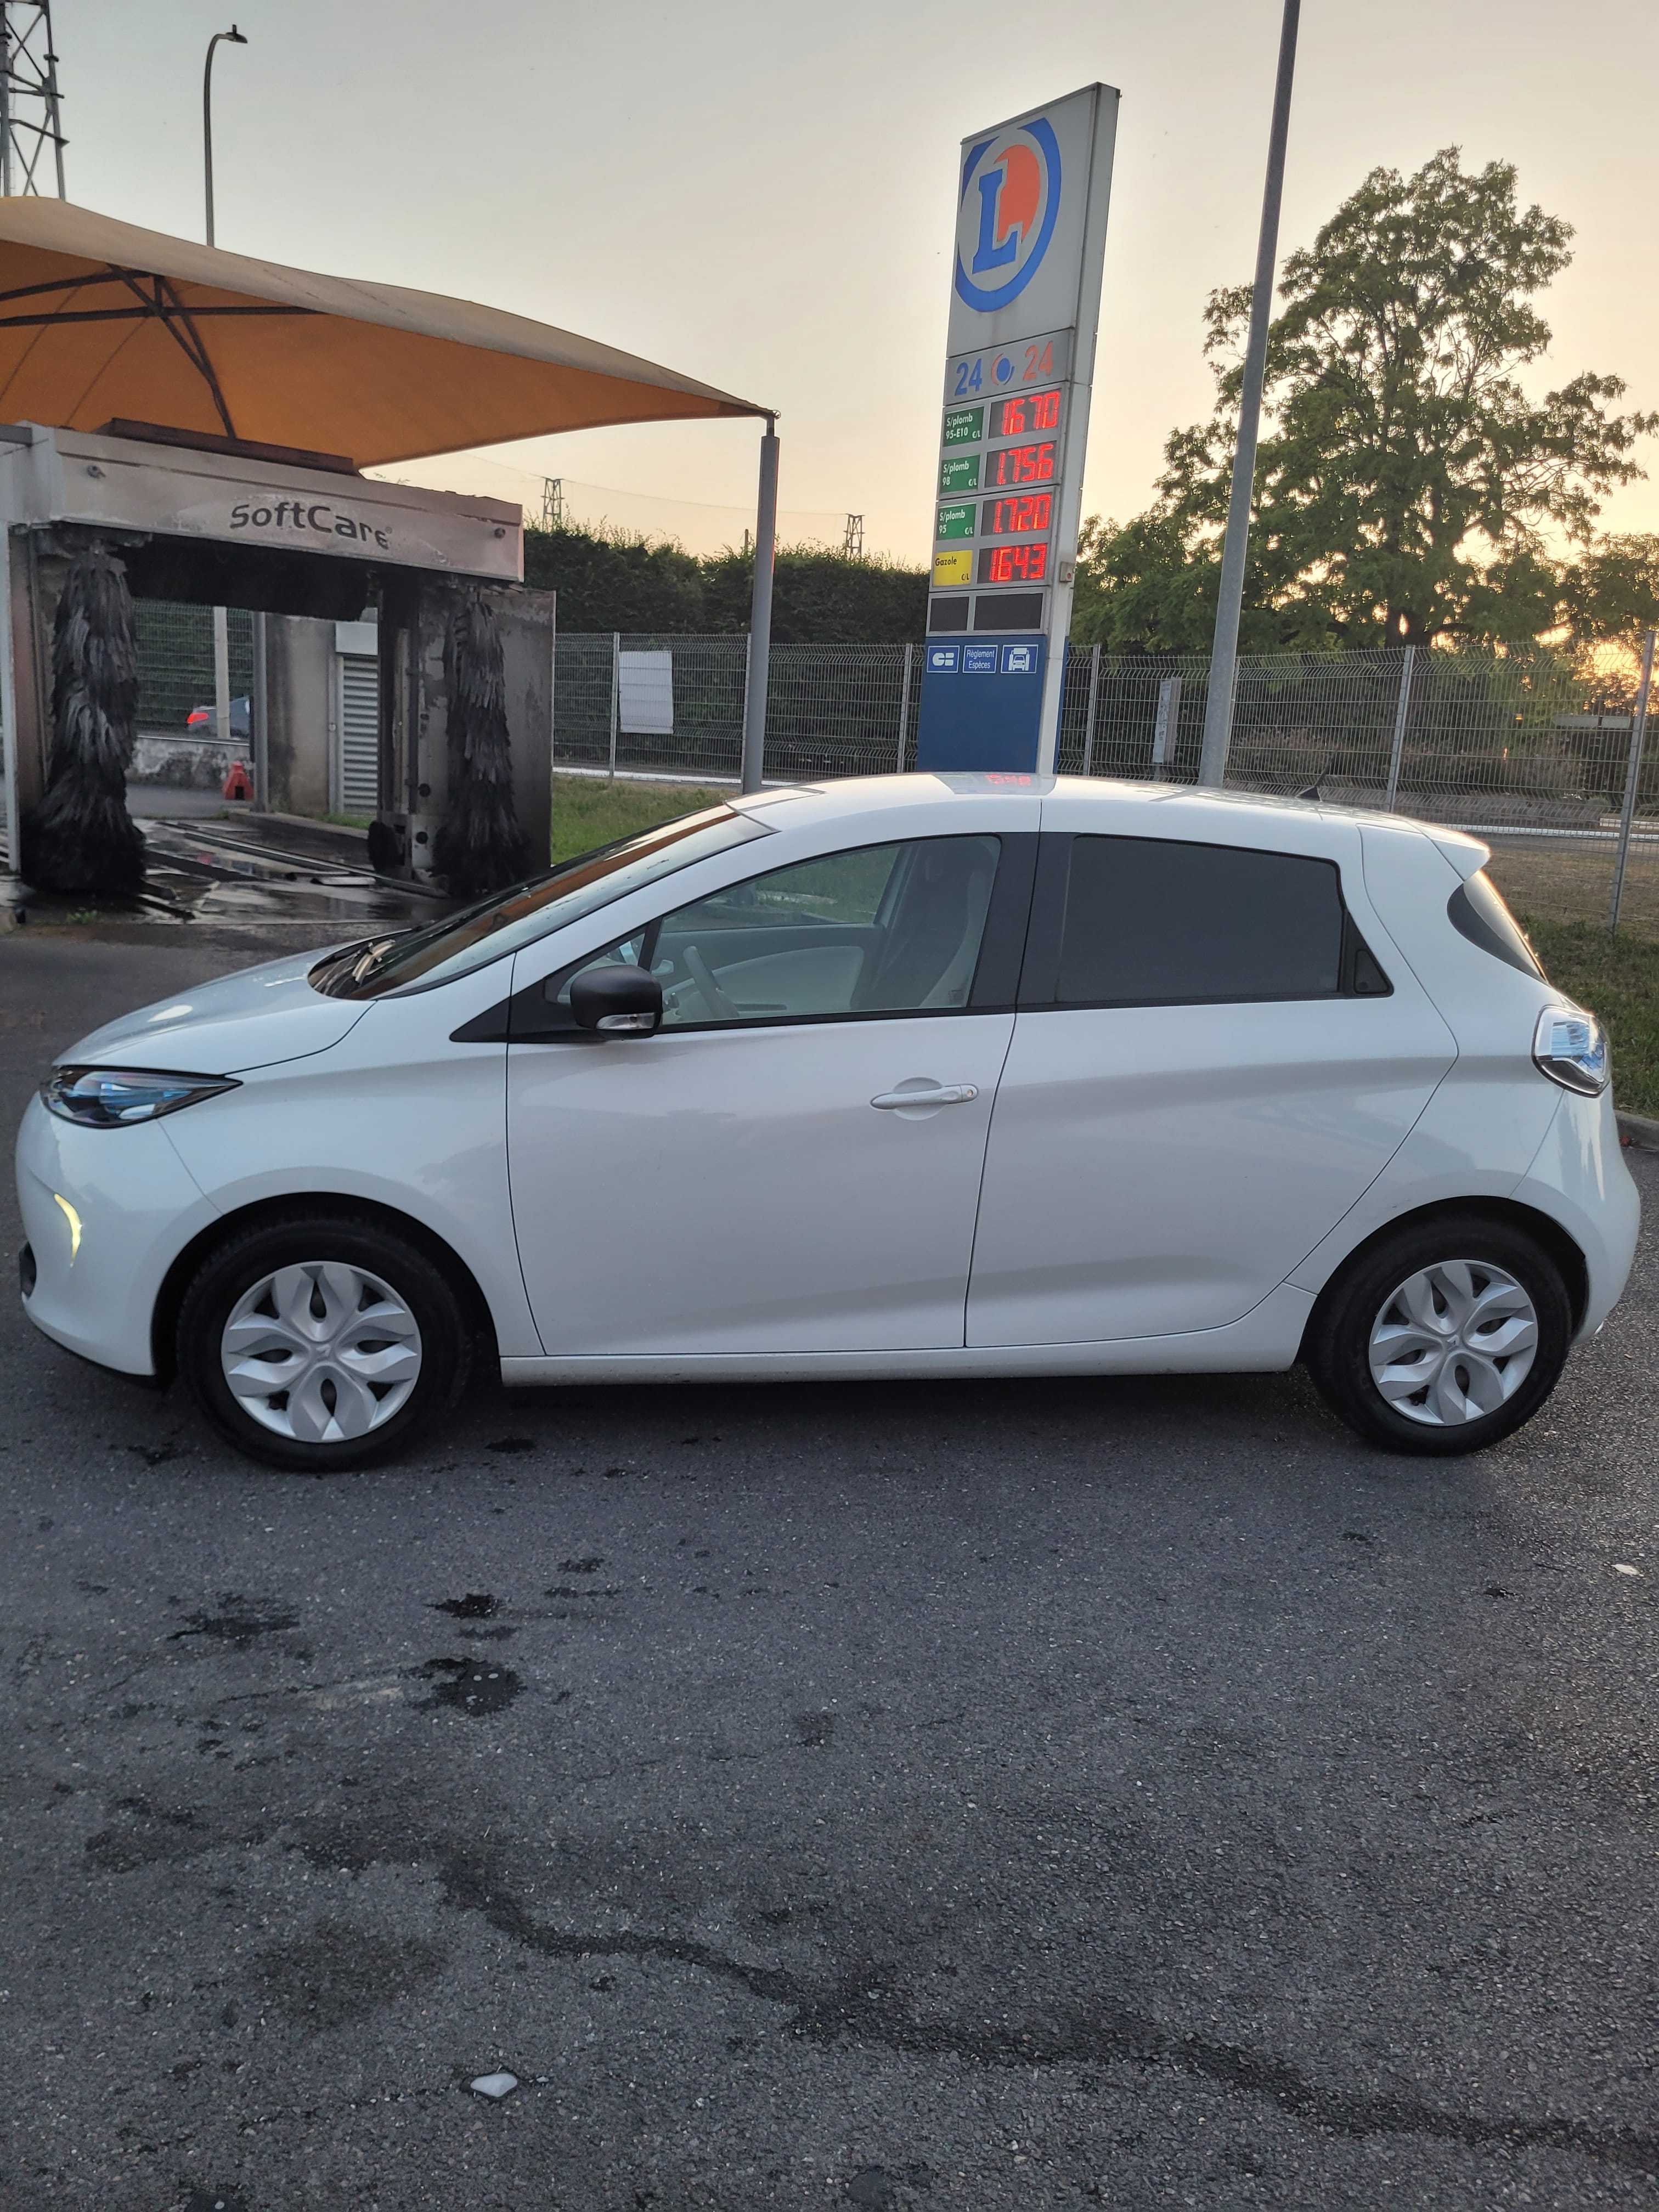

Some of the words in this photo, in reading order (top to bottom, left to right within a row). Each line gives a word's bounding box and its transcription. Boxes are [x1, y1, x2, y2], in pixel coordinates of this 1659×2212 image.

[972, 168, 1018, 274] L
[955, 358, 982, 396] 24
[1023, 341, 1054, 381] 24
[946, 413, 973, 427] S/plomb
[946, 427, 968, 439] 95-E10
[972, 430, 981, 439] €/L
[943, 461, 969, 475] S/plomb
[943, 476, 950, 486] 98
[968, 478, 977, 487] €/L
[939, 509, 966, 523] S/plomb
[939, 524, 947, 534] 95
[964, 526, 973, 535] €/L
[935, 556, 957, 566] Gazole
[966, 650, 995, 659] Règlement
[968, 660, 991, 670] Espèces
